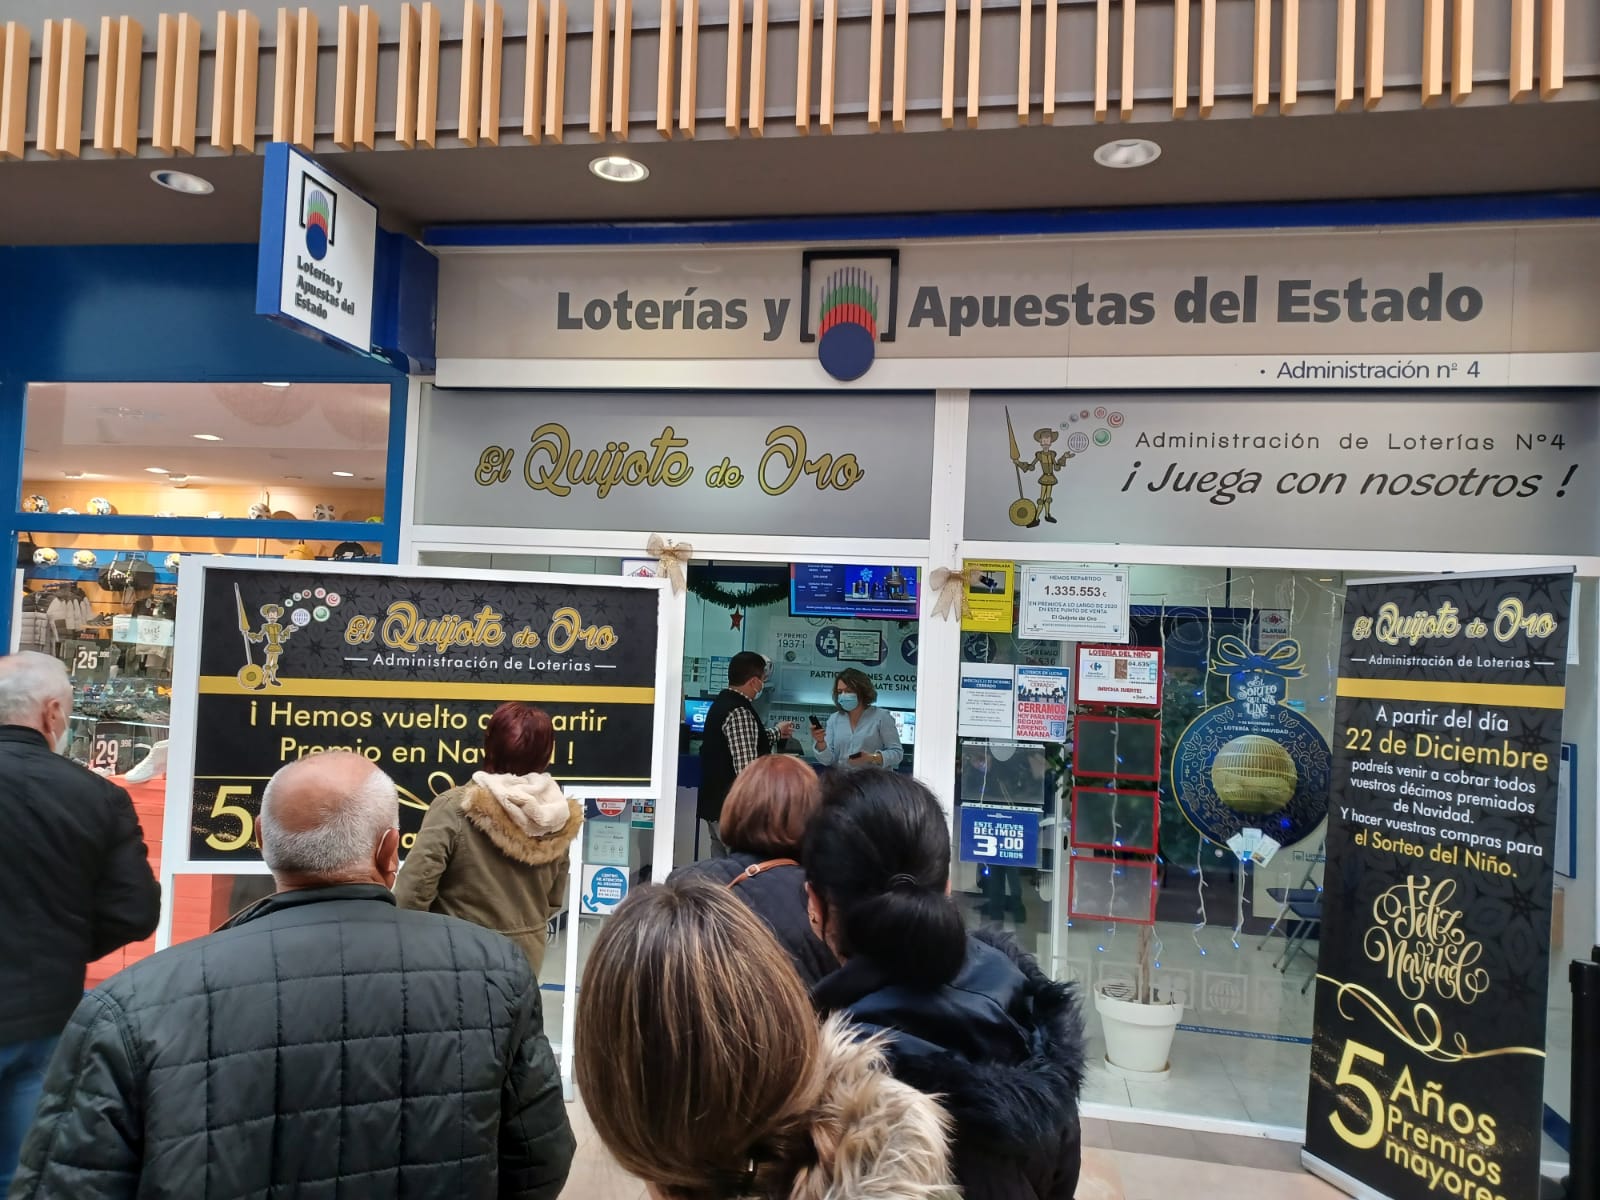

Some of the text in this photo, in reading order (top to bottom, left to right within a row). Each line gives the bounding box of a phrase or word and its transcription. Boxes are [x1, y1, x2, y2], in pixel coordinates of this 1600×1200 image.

[297, 255, 342, 294] Loterías y
[295, 292, 327, 319] Estado
[296, 275, 354, 316] Apuestas del
[557, 272, 1483, 342] Loterías y Apuestas del Estado
[1276, 360, 1430, 380] Administración
[1467, 361, 1480, 379] 4
[1136, 432, 1319, 450] Administración
[1339, 433, 1368, 450] de
[1388, 433, 1495, 450] Loterías
[475, 422, 864, 498] El Quijote de Oro
[1148, 462, 1262, 506] Juega
[1276, 469, 1348, 496] con
[1360, 467, 1542, 498] nosotros
[1556, 464, 1578, 498] !
[1044, 585, 1100, 597] 1.335.553
[344, 600, 618, 654] El Quijote de Oro
[1352, 596, 1557, 646] El Quijote de Oro
[78, 651, 98, 669] 25
[373, 653, 498, 669] Administración
[504, 657, 522, 670] de
[778, 639, 805, 648] 19371
[1369, 654, 1454, 667] Administración
[1458, 656, 1472, 667] de
[896, 683, 909, 691] SIN
[270, 701, 372, 728] Hemos
[383, 704, 467, 729] vuelto
[1018, 703, 1066, 714] CERRAMOS
[1376, 706, 1509, 732] A partir del día
[96, 740, 118, 765] 29
[392, 746, 426, 763] en
[568, 740, 575, 765] !
[1345, 728, 1549, 772] 22 de Diciembre
[1352, 759, 1536, 794] podreís venir a cobrar todos
[1351, 777, 1535, 814] vuestros décimos premiados
[1393, 798, 1474, 824] de Navidad.
[205, 785, 253, 851] 5
[1340, 806, 1543, 856] Y hacer vuestras compras para
[1000, 851, 1023, 859] EUROS
[1355, 828, 1517, 878] el Sorteo del Niño.
[1373, 874, 1465, 946] Feliz
[1364, 926, 1490, 1005] Navidad
[1329, 1038, 1385, 1149] 5
[1390, 1064, 1497, 1146] Años
[1387, 1104, 1502, 1186] Premios
[1385, 1139, 1508, 1200] mayore
